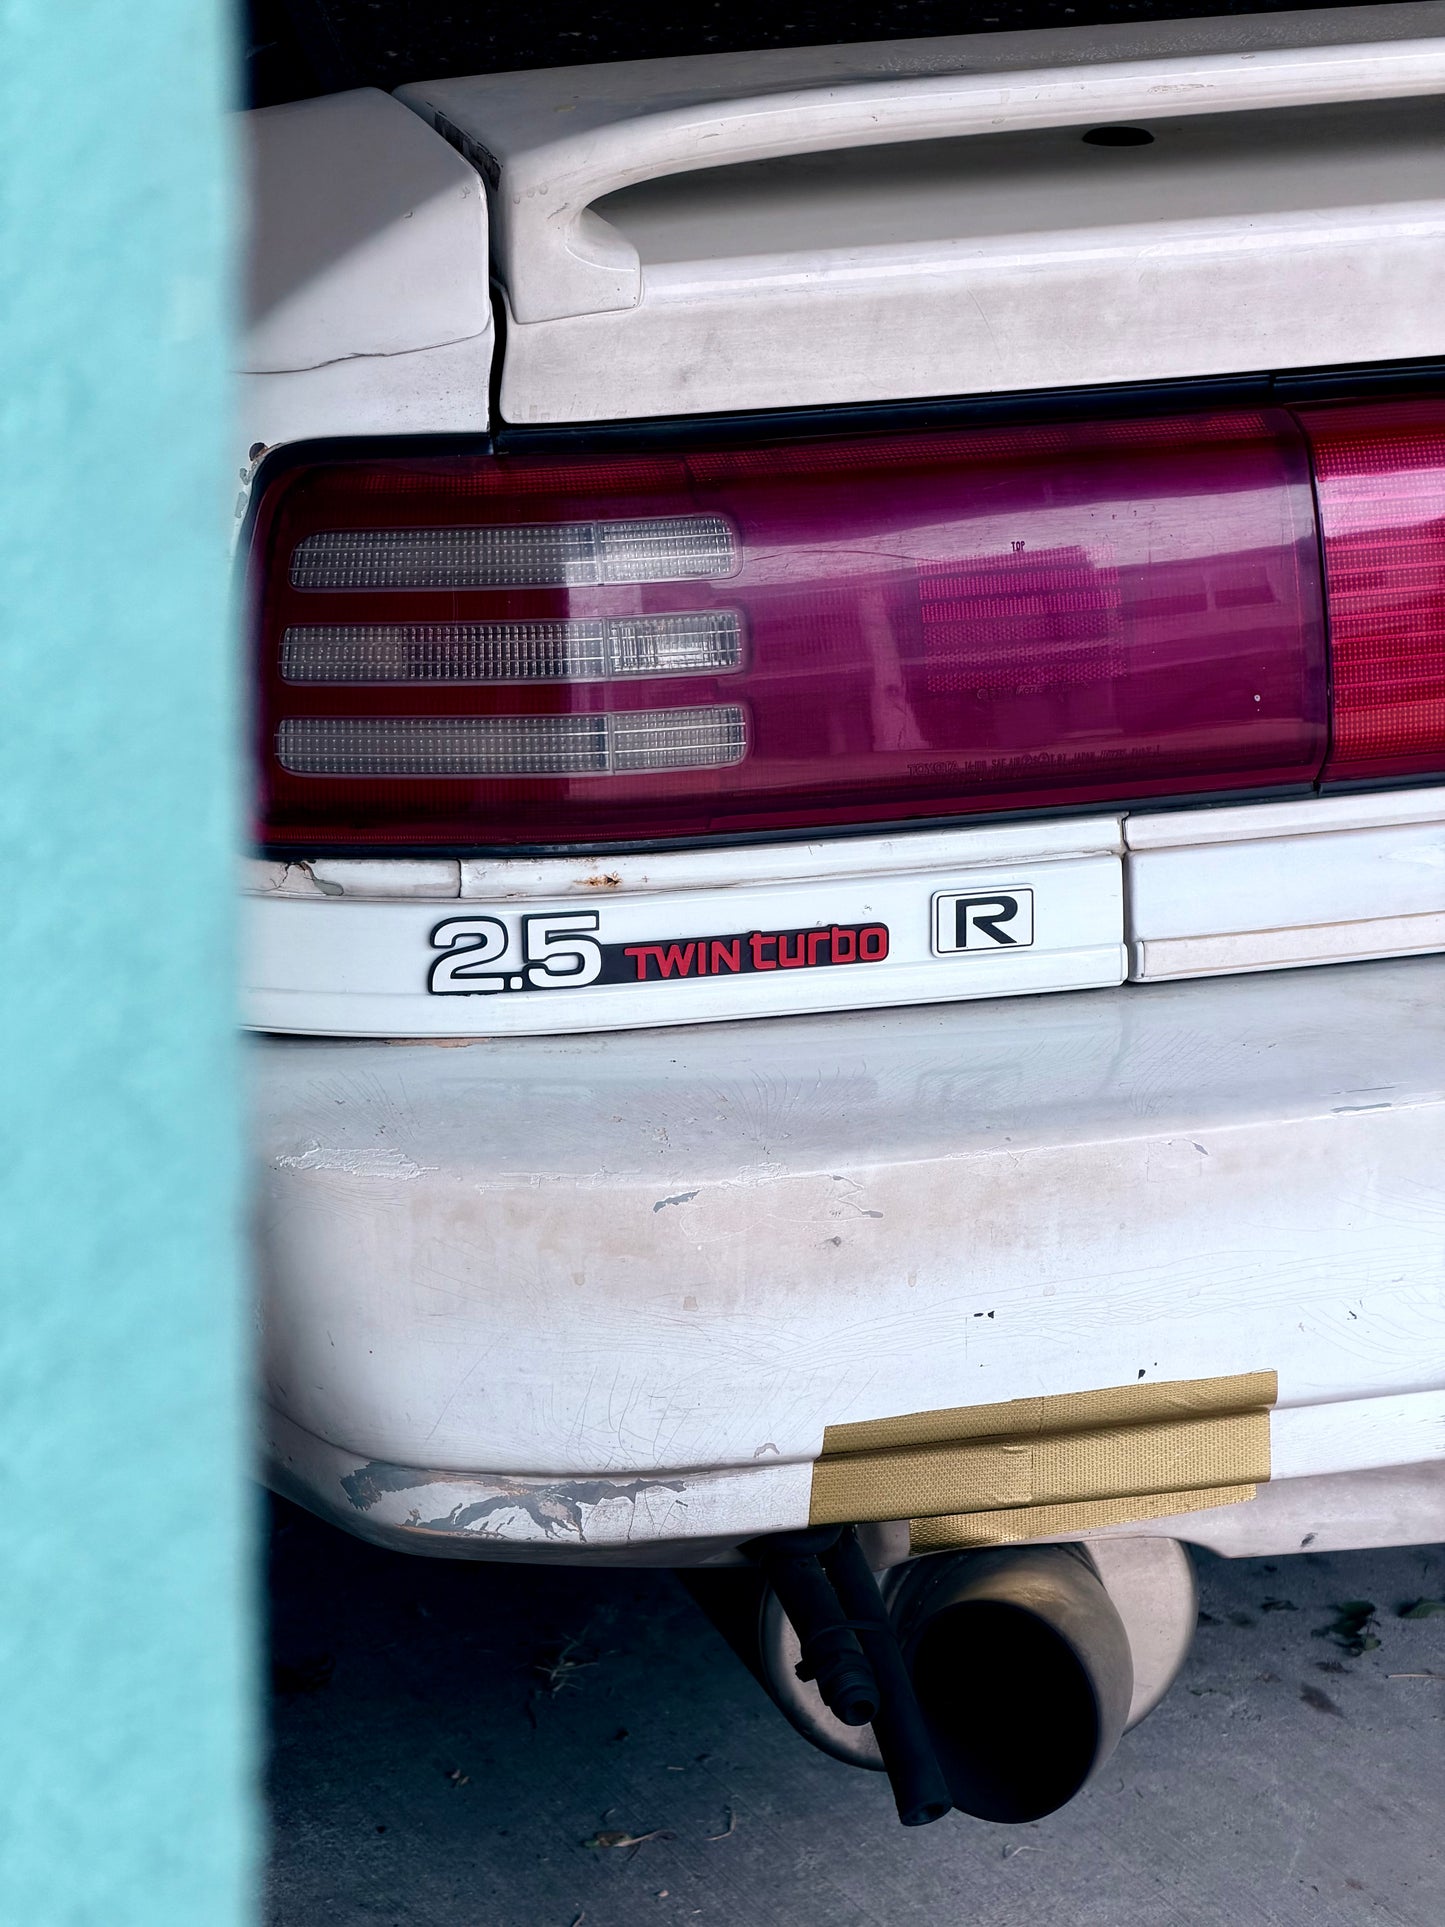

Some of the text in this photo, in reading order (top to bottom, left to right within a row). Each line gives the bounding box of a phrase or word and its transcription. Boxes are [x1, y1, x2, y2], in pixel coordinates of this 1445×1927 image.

[1010, 540, 1026, 552] TOP
[907, 760, 958, 776] TOYOTA
[955, 895, 1019, 949] R
[428, 910, 888, 996] 2.5 TWIN turbo
